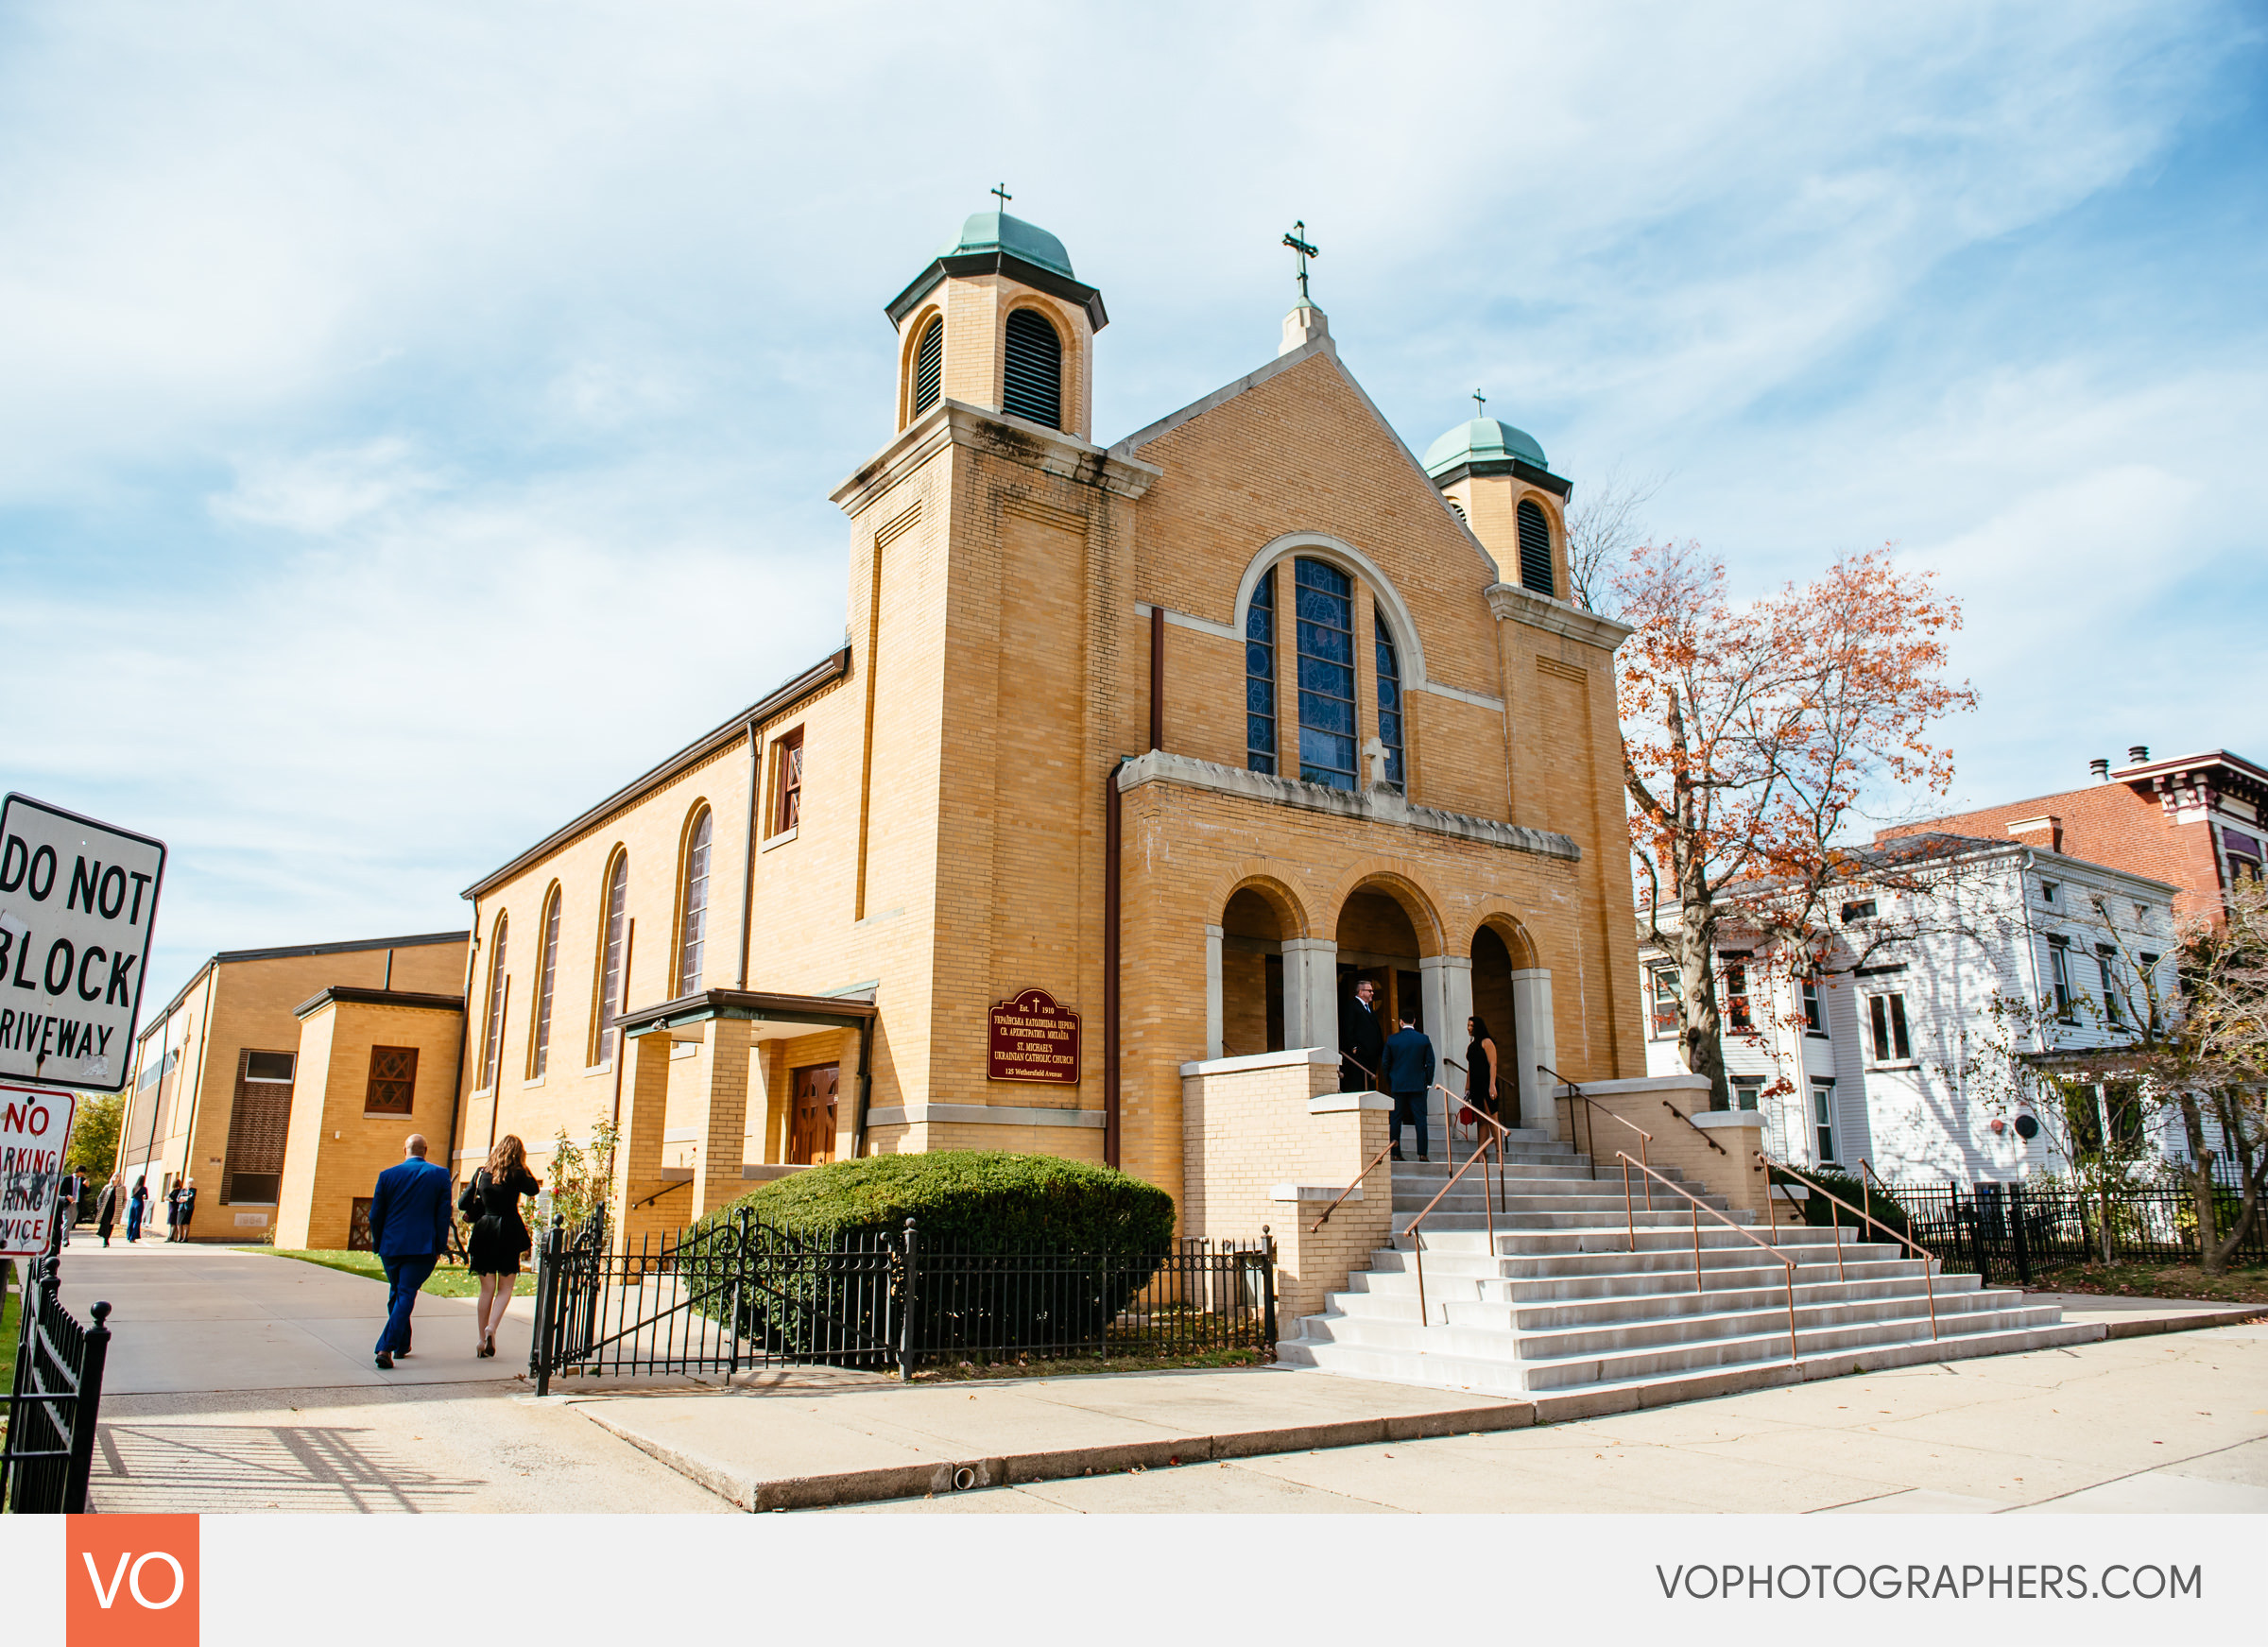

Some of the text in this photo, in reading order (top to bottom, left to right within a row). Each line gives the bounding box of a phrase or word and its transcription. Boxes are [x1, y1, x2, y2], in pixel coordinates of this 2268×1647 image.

[0, 833, 152, 926] DO NOT
[0, 1008, 113, 1059] RIVEWAY
[1017, 1042, 1053, 1053] ST. MICHAEL'S
[994, 1051, 1074, 1064] UKRAINIAN CATHOLIC CHURCH
[1015, 1069, 1044, 1077] Wethersfield
[4, 1102, 49, 1137] NO
[0, 1146, 56, 1175] RKING
